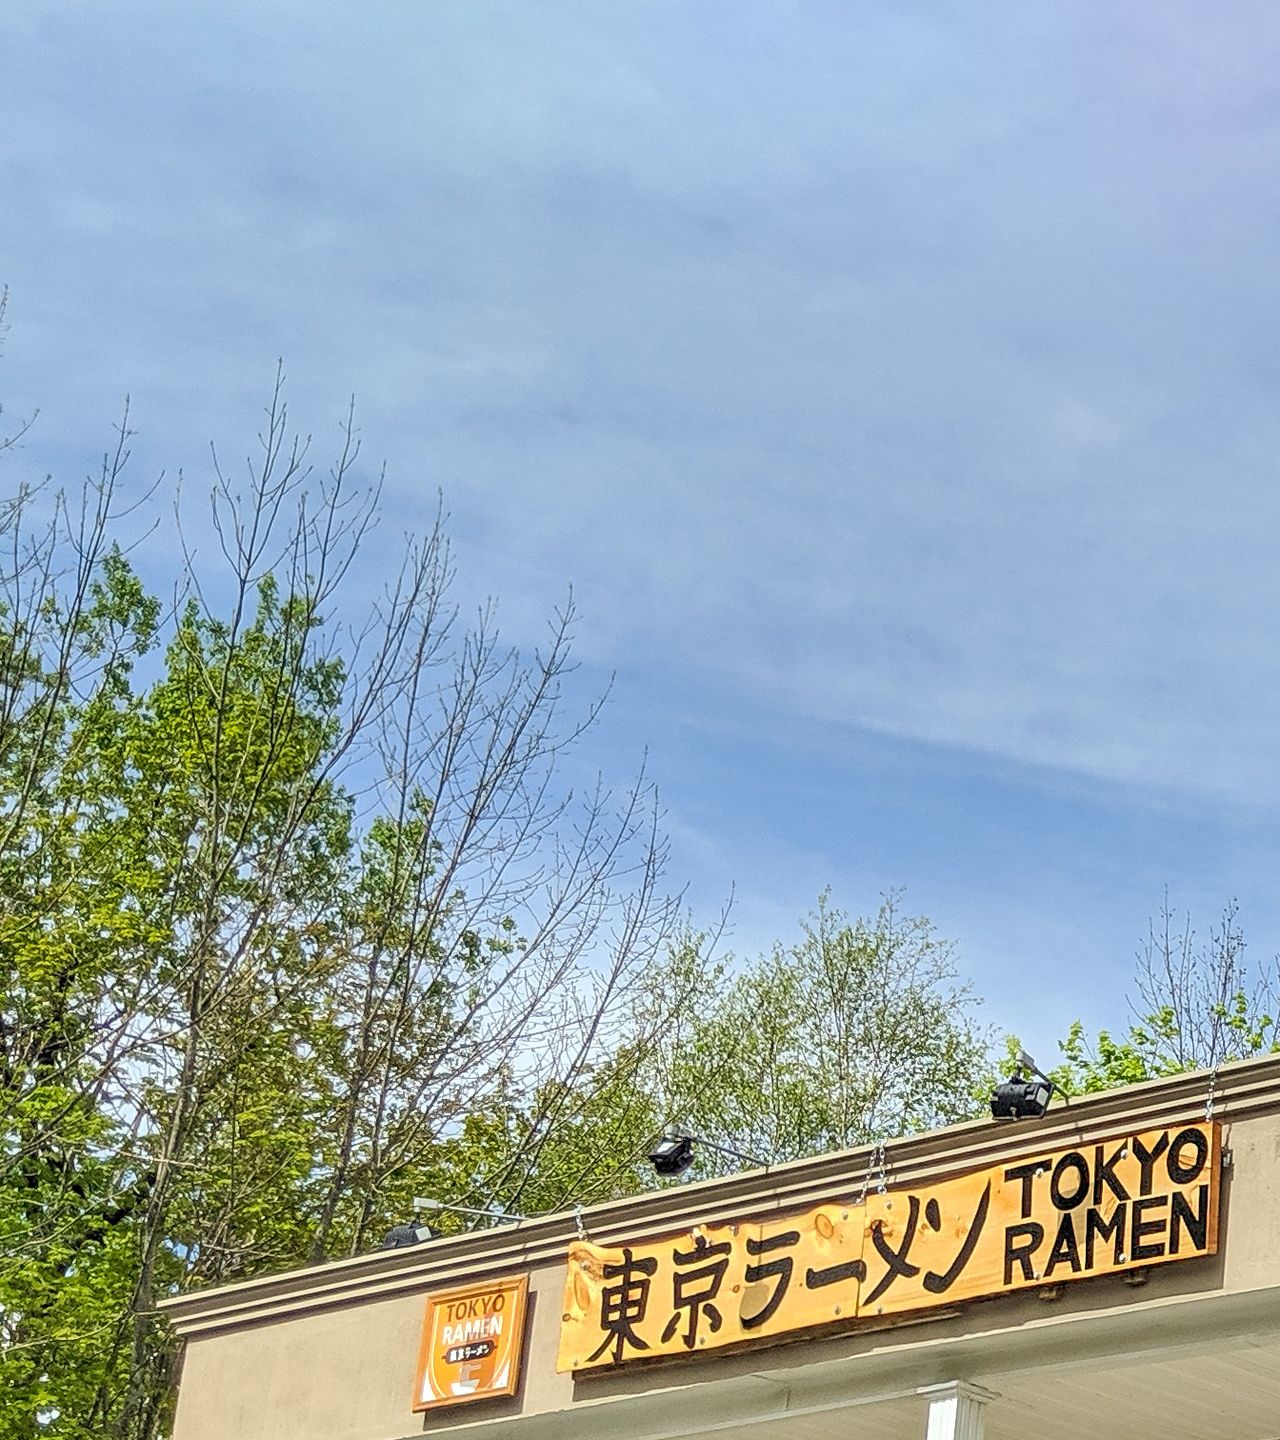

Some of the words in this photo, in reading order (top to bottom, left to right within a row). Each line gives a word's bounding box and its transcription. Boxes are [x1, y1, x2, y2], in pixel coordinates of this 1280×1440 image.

[1004, 1127, 1208, 1219] TOKYO
[587, 1177, 992, 1362] 東京ラーメン
[1003, 1184, 1209, 1286] RAMEN
[442, 1315, 504, 1345] RAMEN
[446, 1293, 505, 1322] TOKYO
